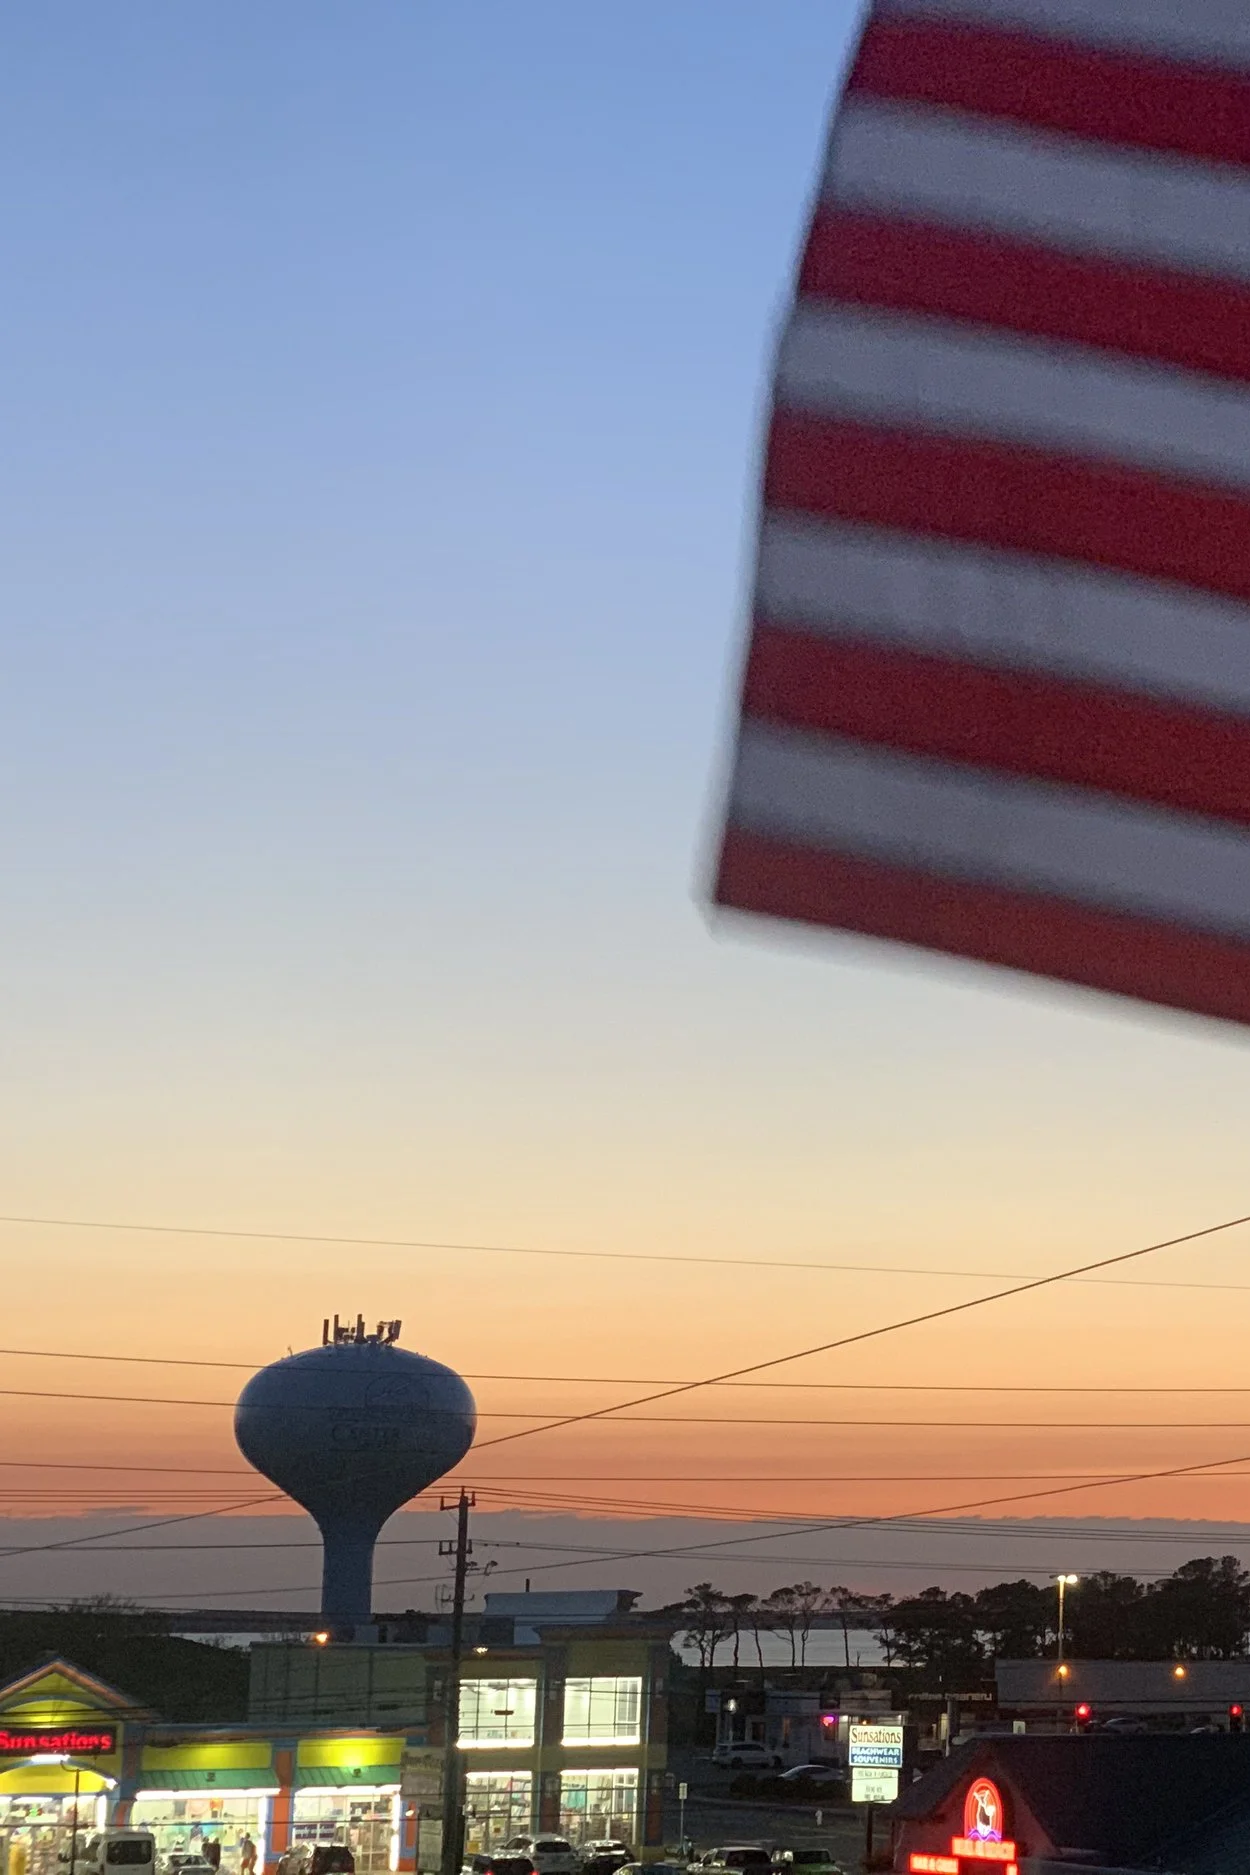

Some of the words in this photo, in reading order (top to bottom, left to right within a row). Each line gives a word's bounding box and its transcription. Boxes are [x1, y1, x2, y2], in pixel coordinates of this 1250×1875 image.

[0, 1730, 112, 1750] Sunsations
[851, 1727, 901, 1744] Sunsations
[851, 1747, 900, 1756] BEACHWEAR
[853, 1756, 898, 1764] SOUVENIRS
